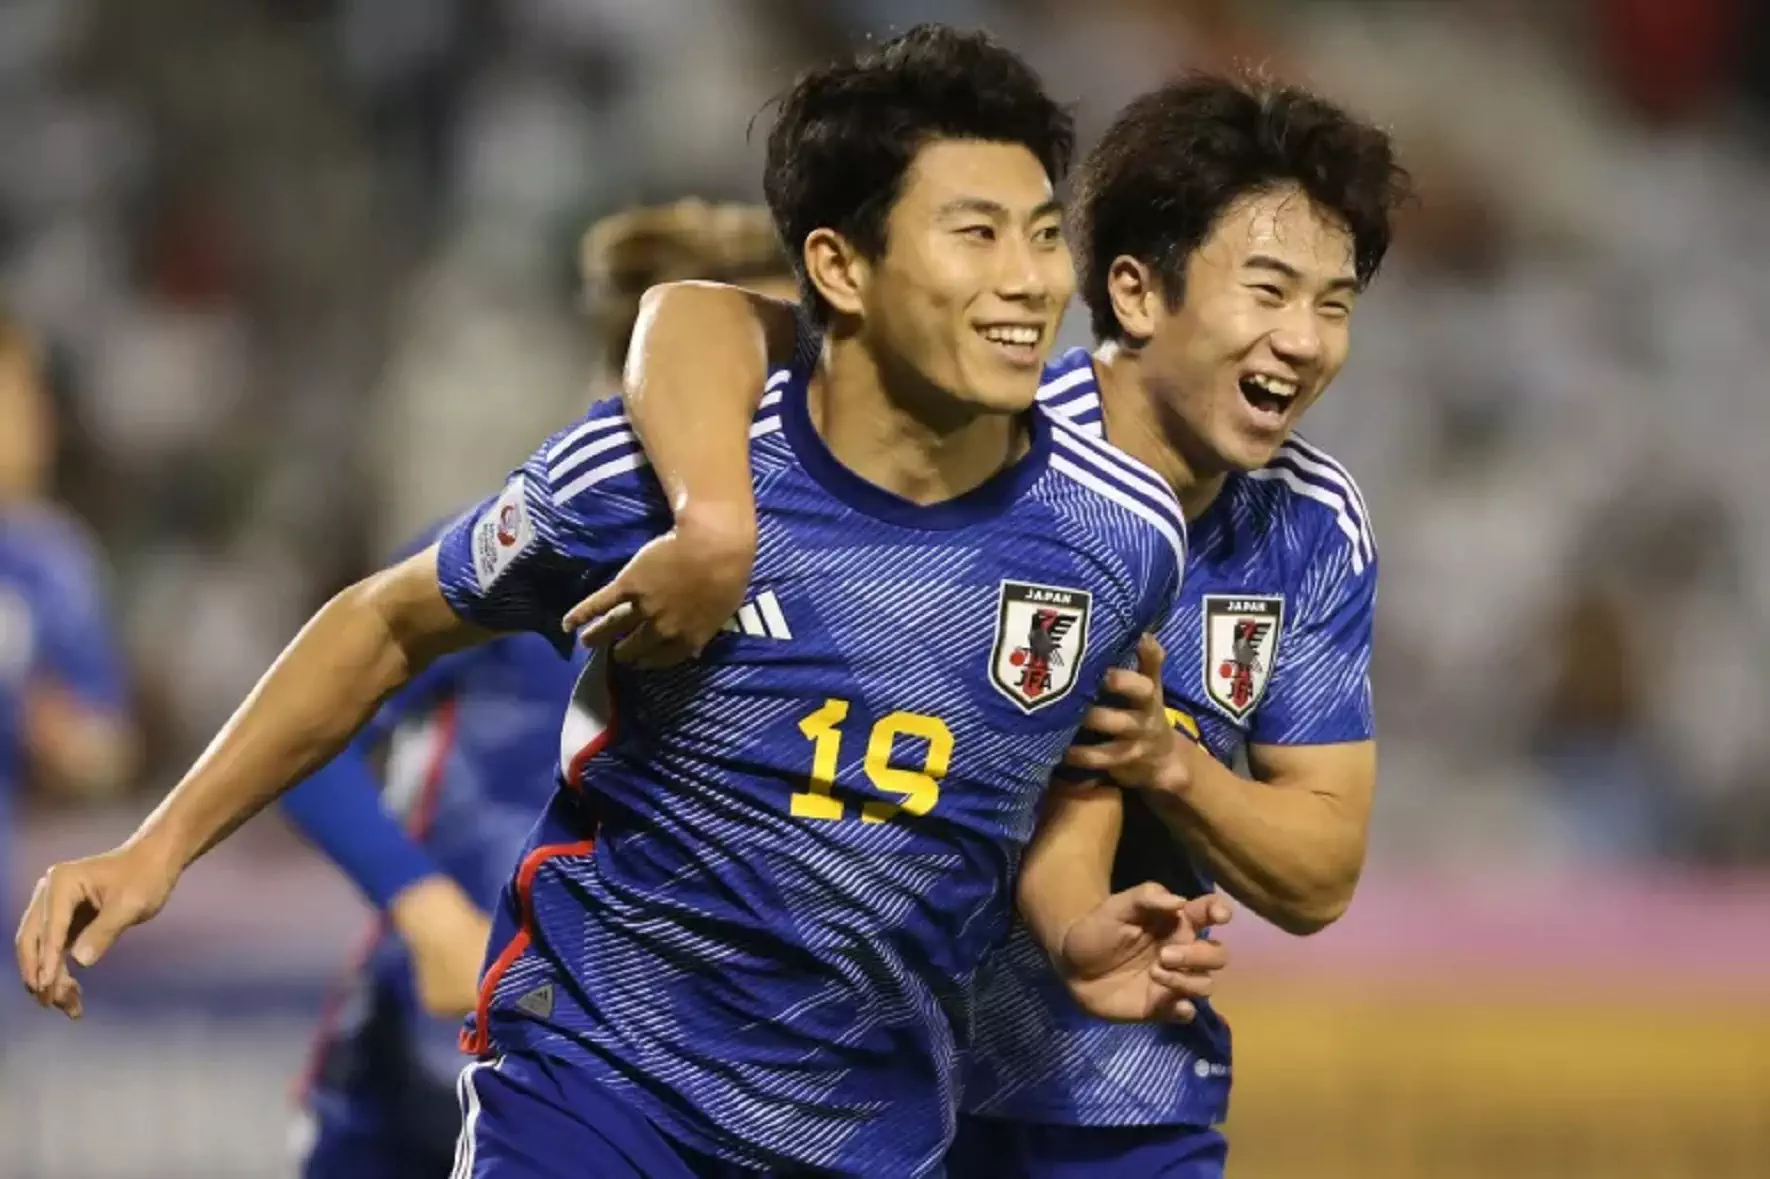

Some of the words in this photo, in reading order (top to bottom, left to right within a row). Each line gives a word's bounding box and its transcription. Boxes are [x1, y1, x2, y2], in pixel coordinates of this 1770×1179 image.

[1025, 588, 1072, 604] JAPAN
[1227, 601, 1267, 612] JAPAN
[1014, 670, 1053, 690] JFA
[790, 699, 955, 824] 19
